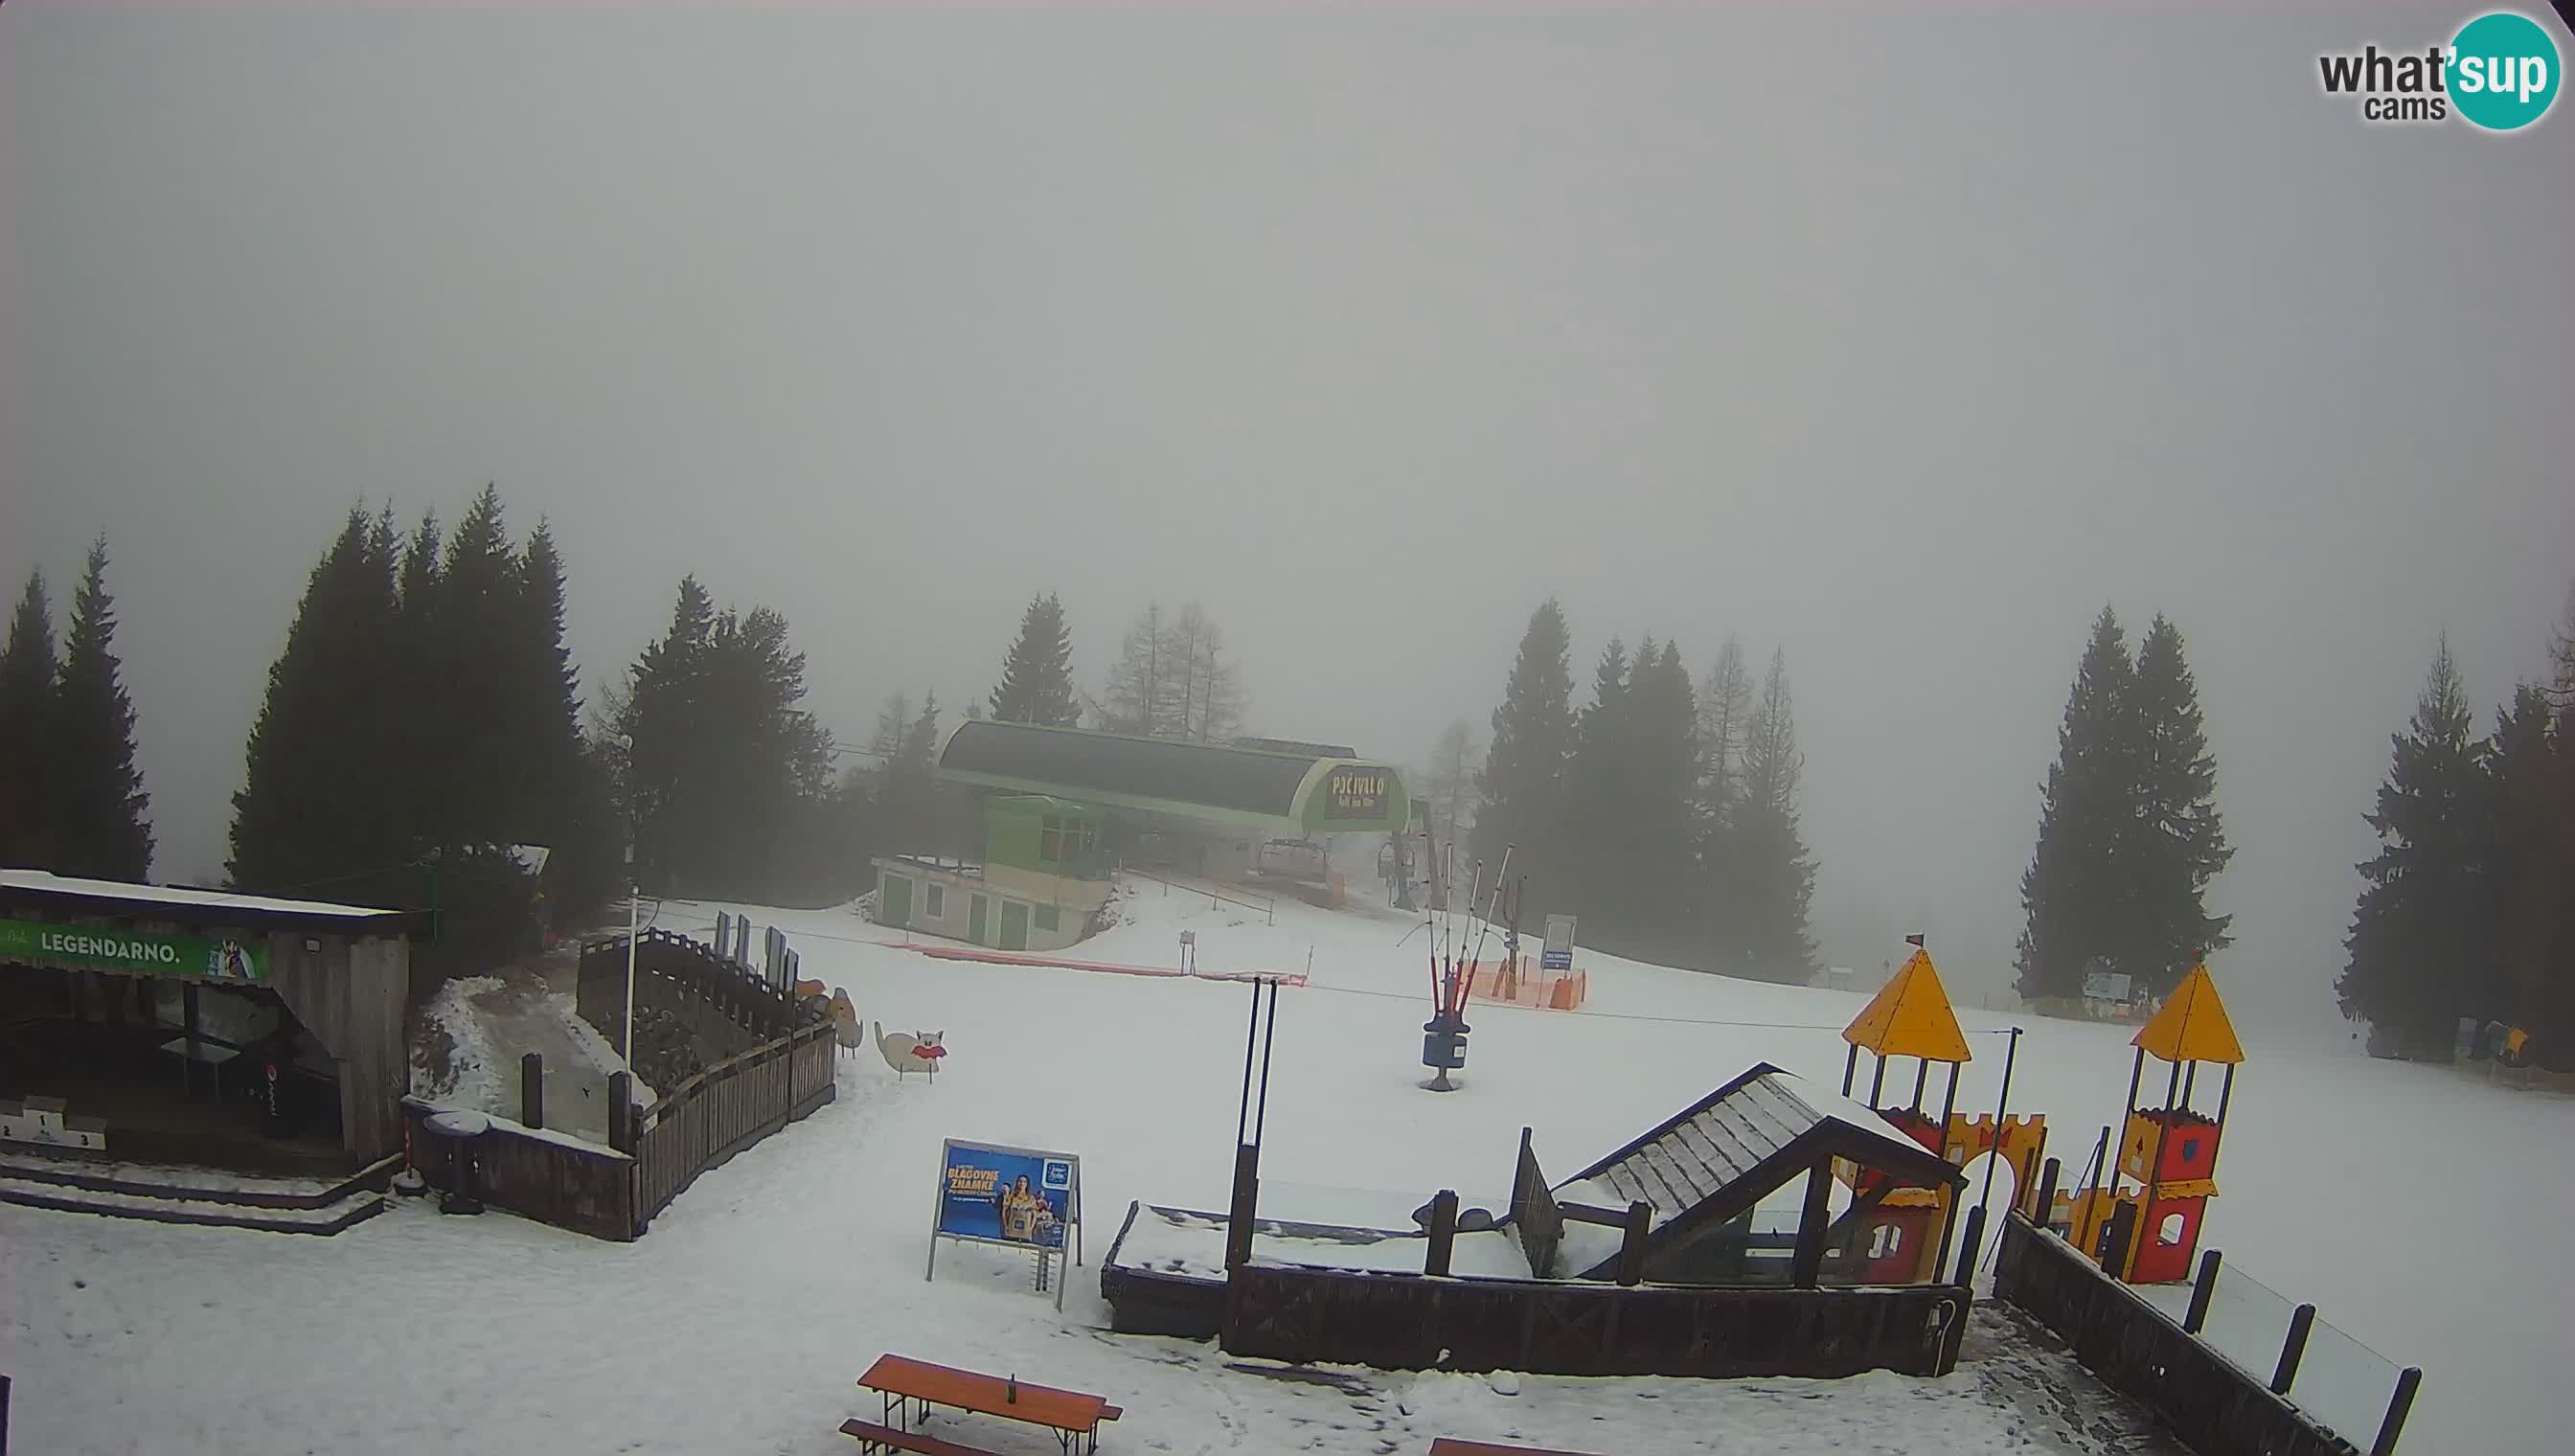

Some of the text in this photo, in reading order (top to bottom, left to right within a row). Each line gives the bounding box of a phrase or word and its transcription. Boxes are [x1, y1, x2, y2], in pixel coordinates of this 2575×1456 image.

[41, 932, 181, 964] LEGENDARNO.
[39, 1114, 46, 1126] 1
[4, 1125, 11, 1137] 2
[80, 1134, 89, 1147] 3
